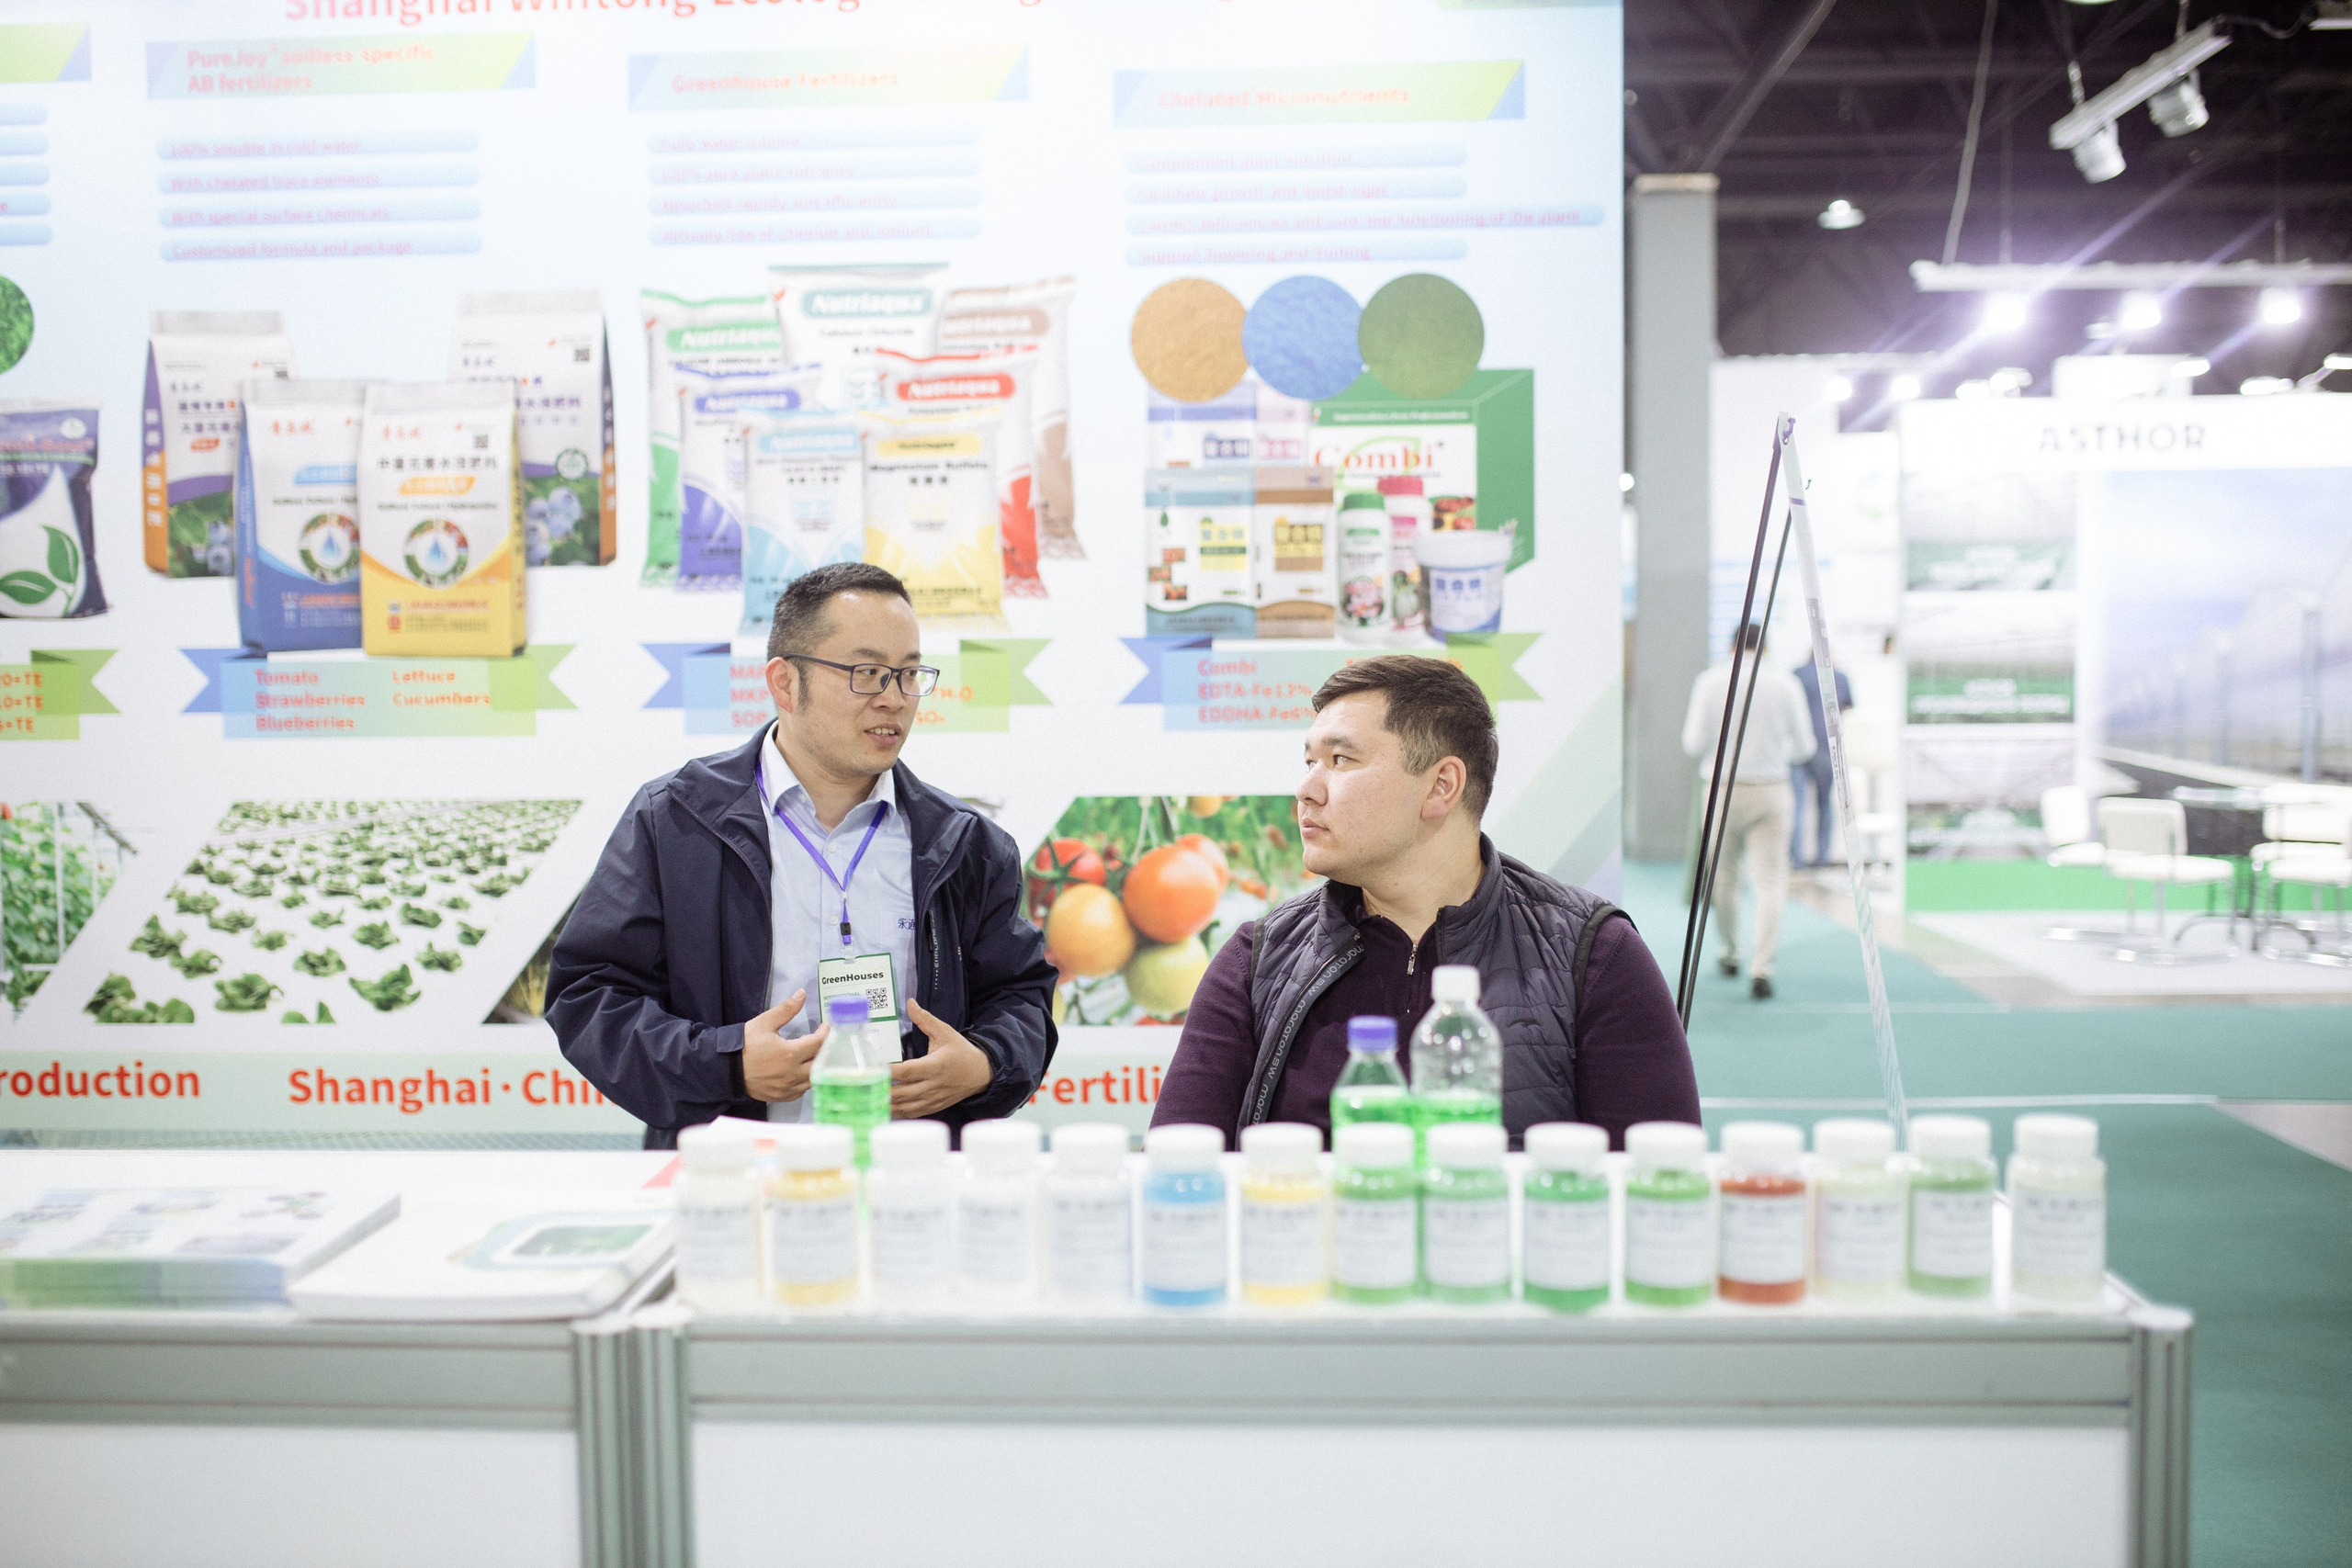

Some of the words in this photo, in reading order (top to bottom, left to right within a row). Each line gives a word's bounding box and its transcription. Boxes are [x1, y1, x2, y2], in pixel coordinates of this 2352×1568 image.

[1314, 444, 1434, 470] Combi
[1197, 659, 1258, 676] Combi
[254, 669, 320, 686] Tomato
[392, 669, 457, 685] Lettuce
[255, 691, 366, 709] Strawberries
[392, 690, 492, 707] Cucumbers
[255, 713, 356, 731] Blueberries
[821, 972, 885, 986] GreenHouses
